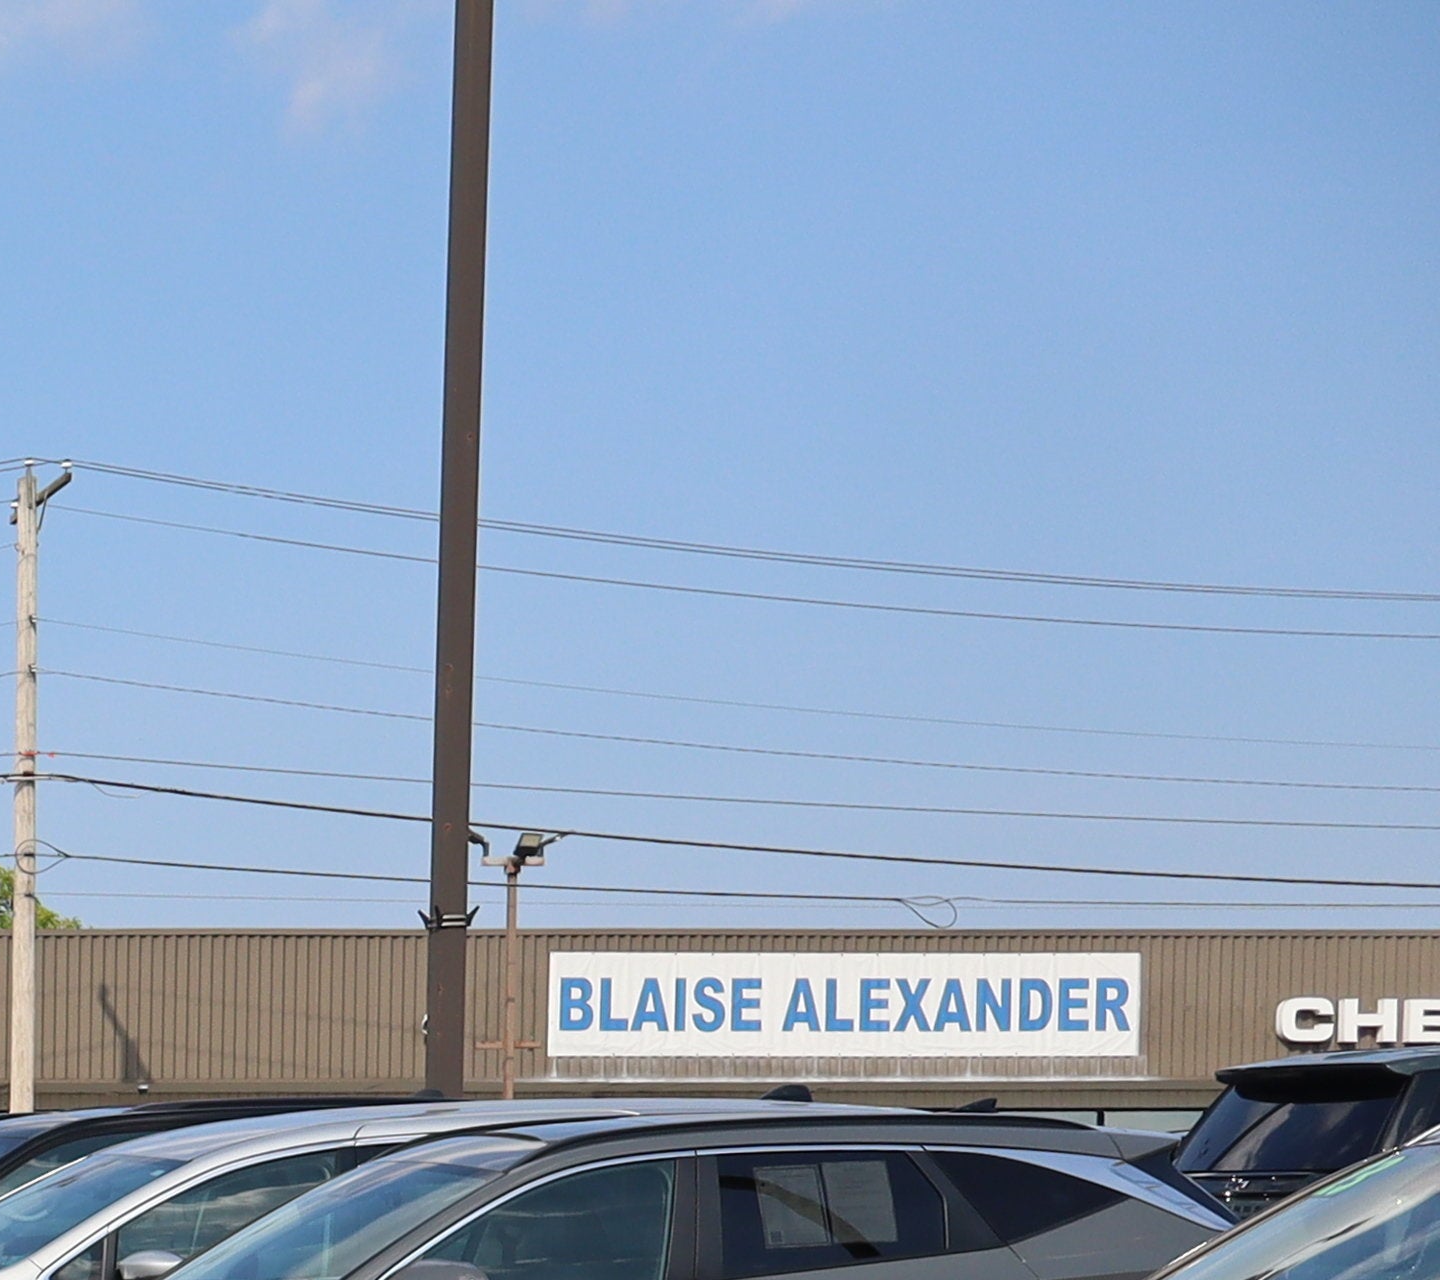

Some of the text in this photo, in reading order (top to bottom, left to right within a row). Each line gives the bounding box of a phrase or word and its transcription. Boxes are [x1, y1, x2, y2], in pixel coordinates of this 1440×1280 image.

[558, 976, 1131, 1033] BLAISE ALEXANDER
[1275, 996, 1440, 1044] CHE
